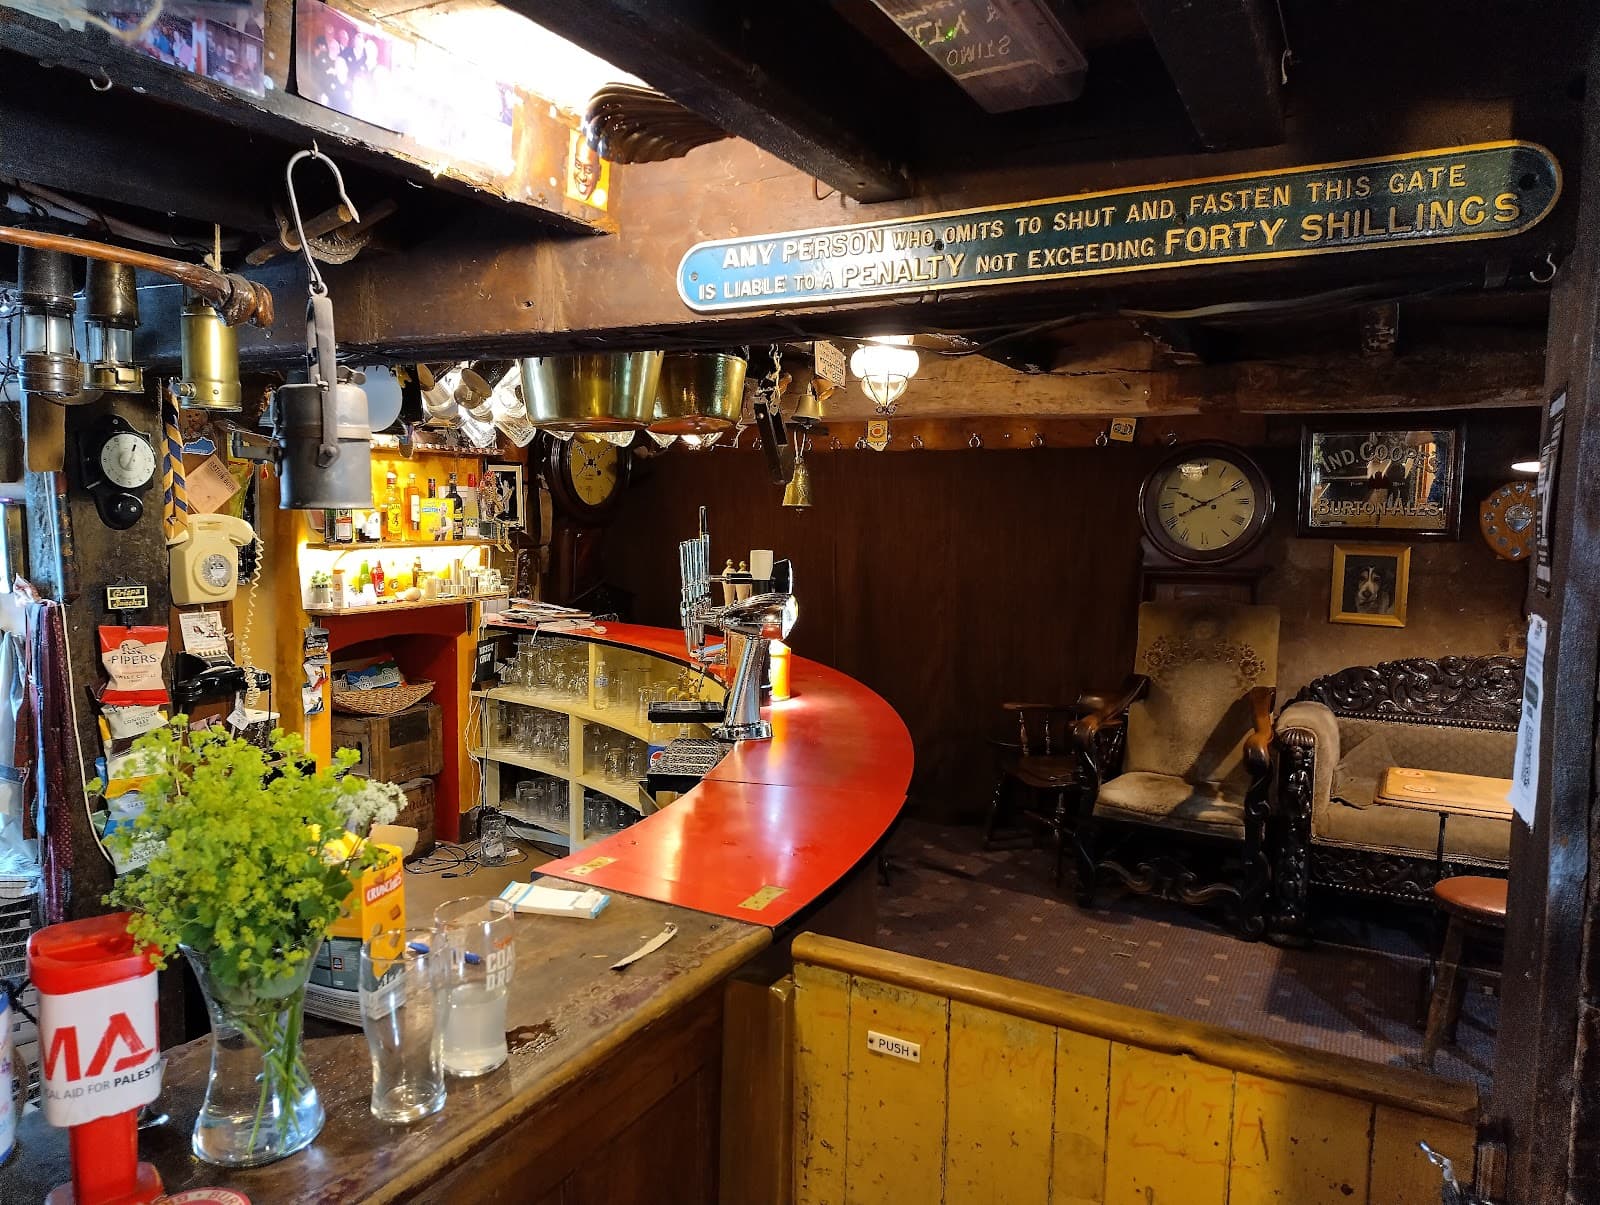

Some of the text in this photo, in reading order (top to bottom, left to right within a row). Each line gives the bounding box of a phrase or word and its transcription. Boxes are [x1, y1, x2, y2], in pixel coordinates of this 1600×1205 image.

[723, 164, 1467, 270] ANY PERSON WHO OMITS TO SHUT AND FASTEN THIS GATE
[697, 191, 1521, 301] IS LIABLE TO A PENALTY NOT EXCEEDING FORTY SHILLINGS
[1317, 497, 1441, 518] BURTON ALES
[110, 653, 157, 665] PIPERS
[878, 1038, 909, 1056] PUSH
[64, 1087, 84, 1099] AID
[87, 1080, 111, 1095] FOR
